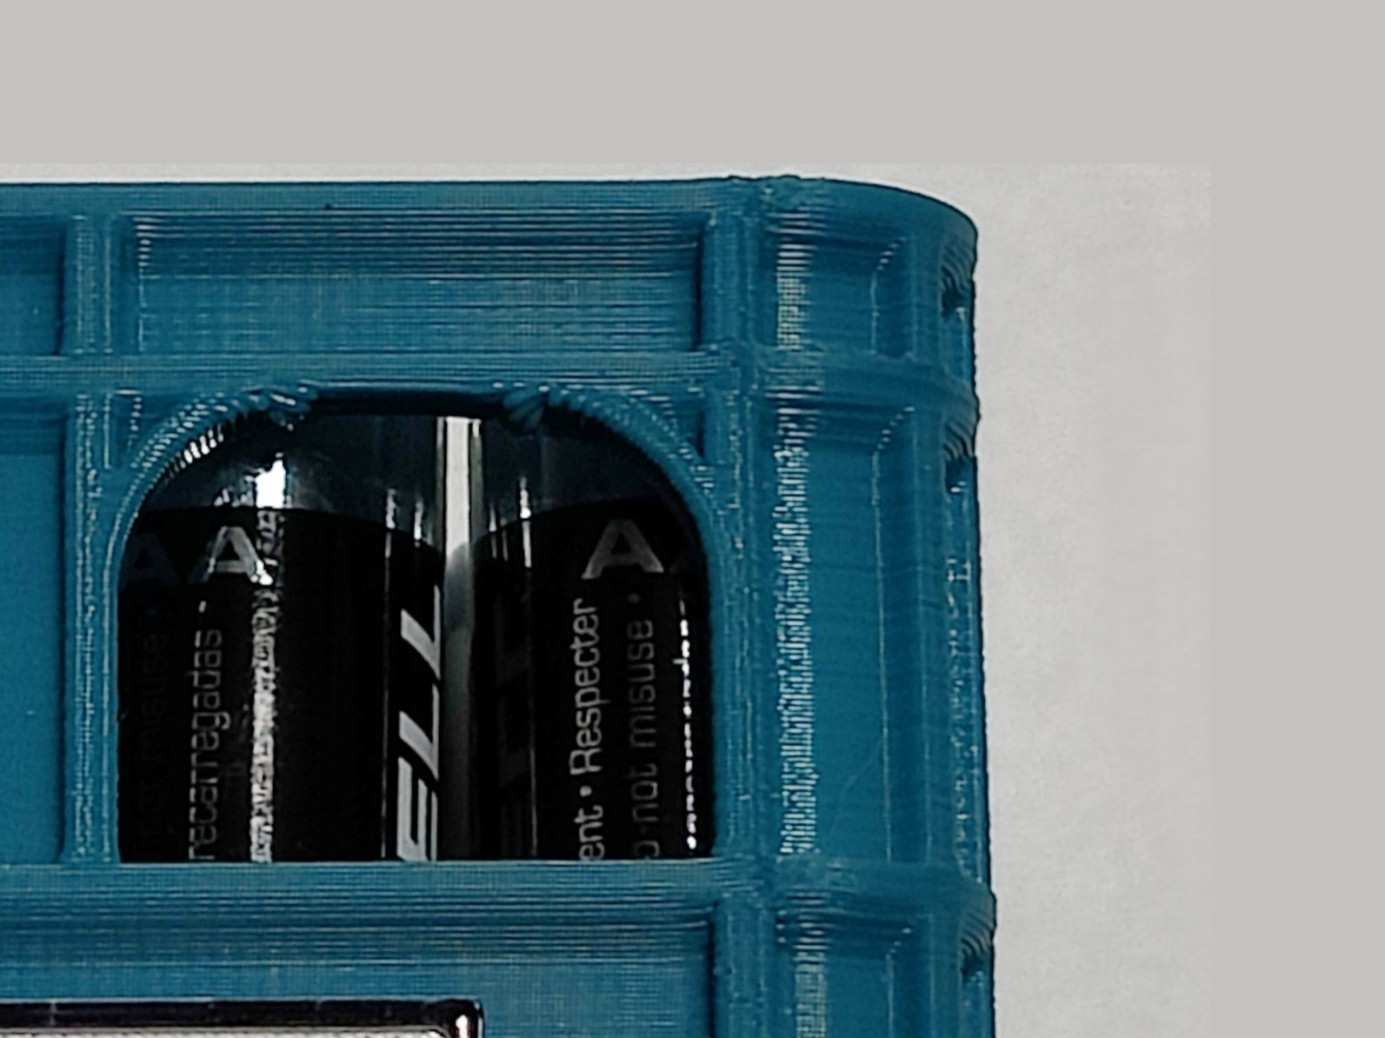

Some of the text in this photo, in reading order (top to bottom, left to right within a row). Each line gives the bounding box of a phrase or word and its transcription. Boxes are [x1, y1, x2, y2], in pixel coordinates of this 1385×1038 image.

[568, 597, 611, 776] Respecter
[625, 618, 658, 749] misuse
[626, 762, 659, 824] not
